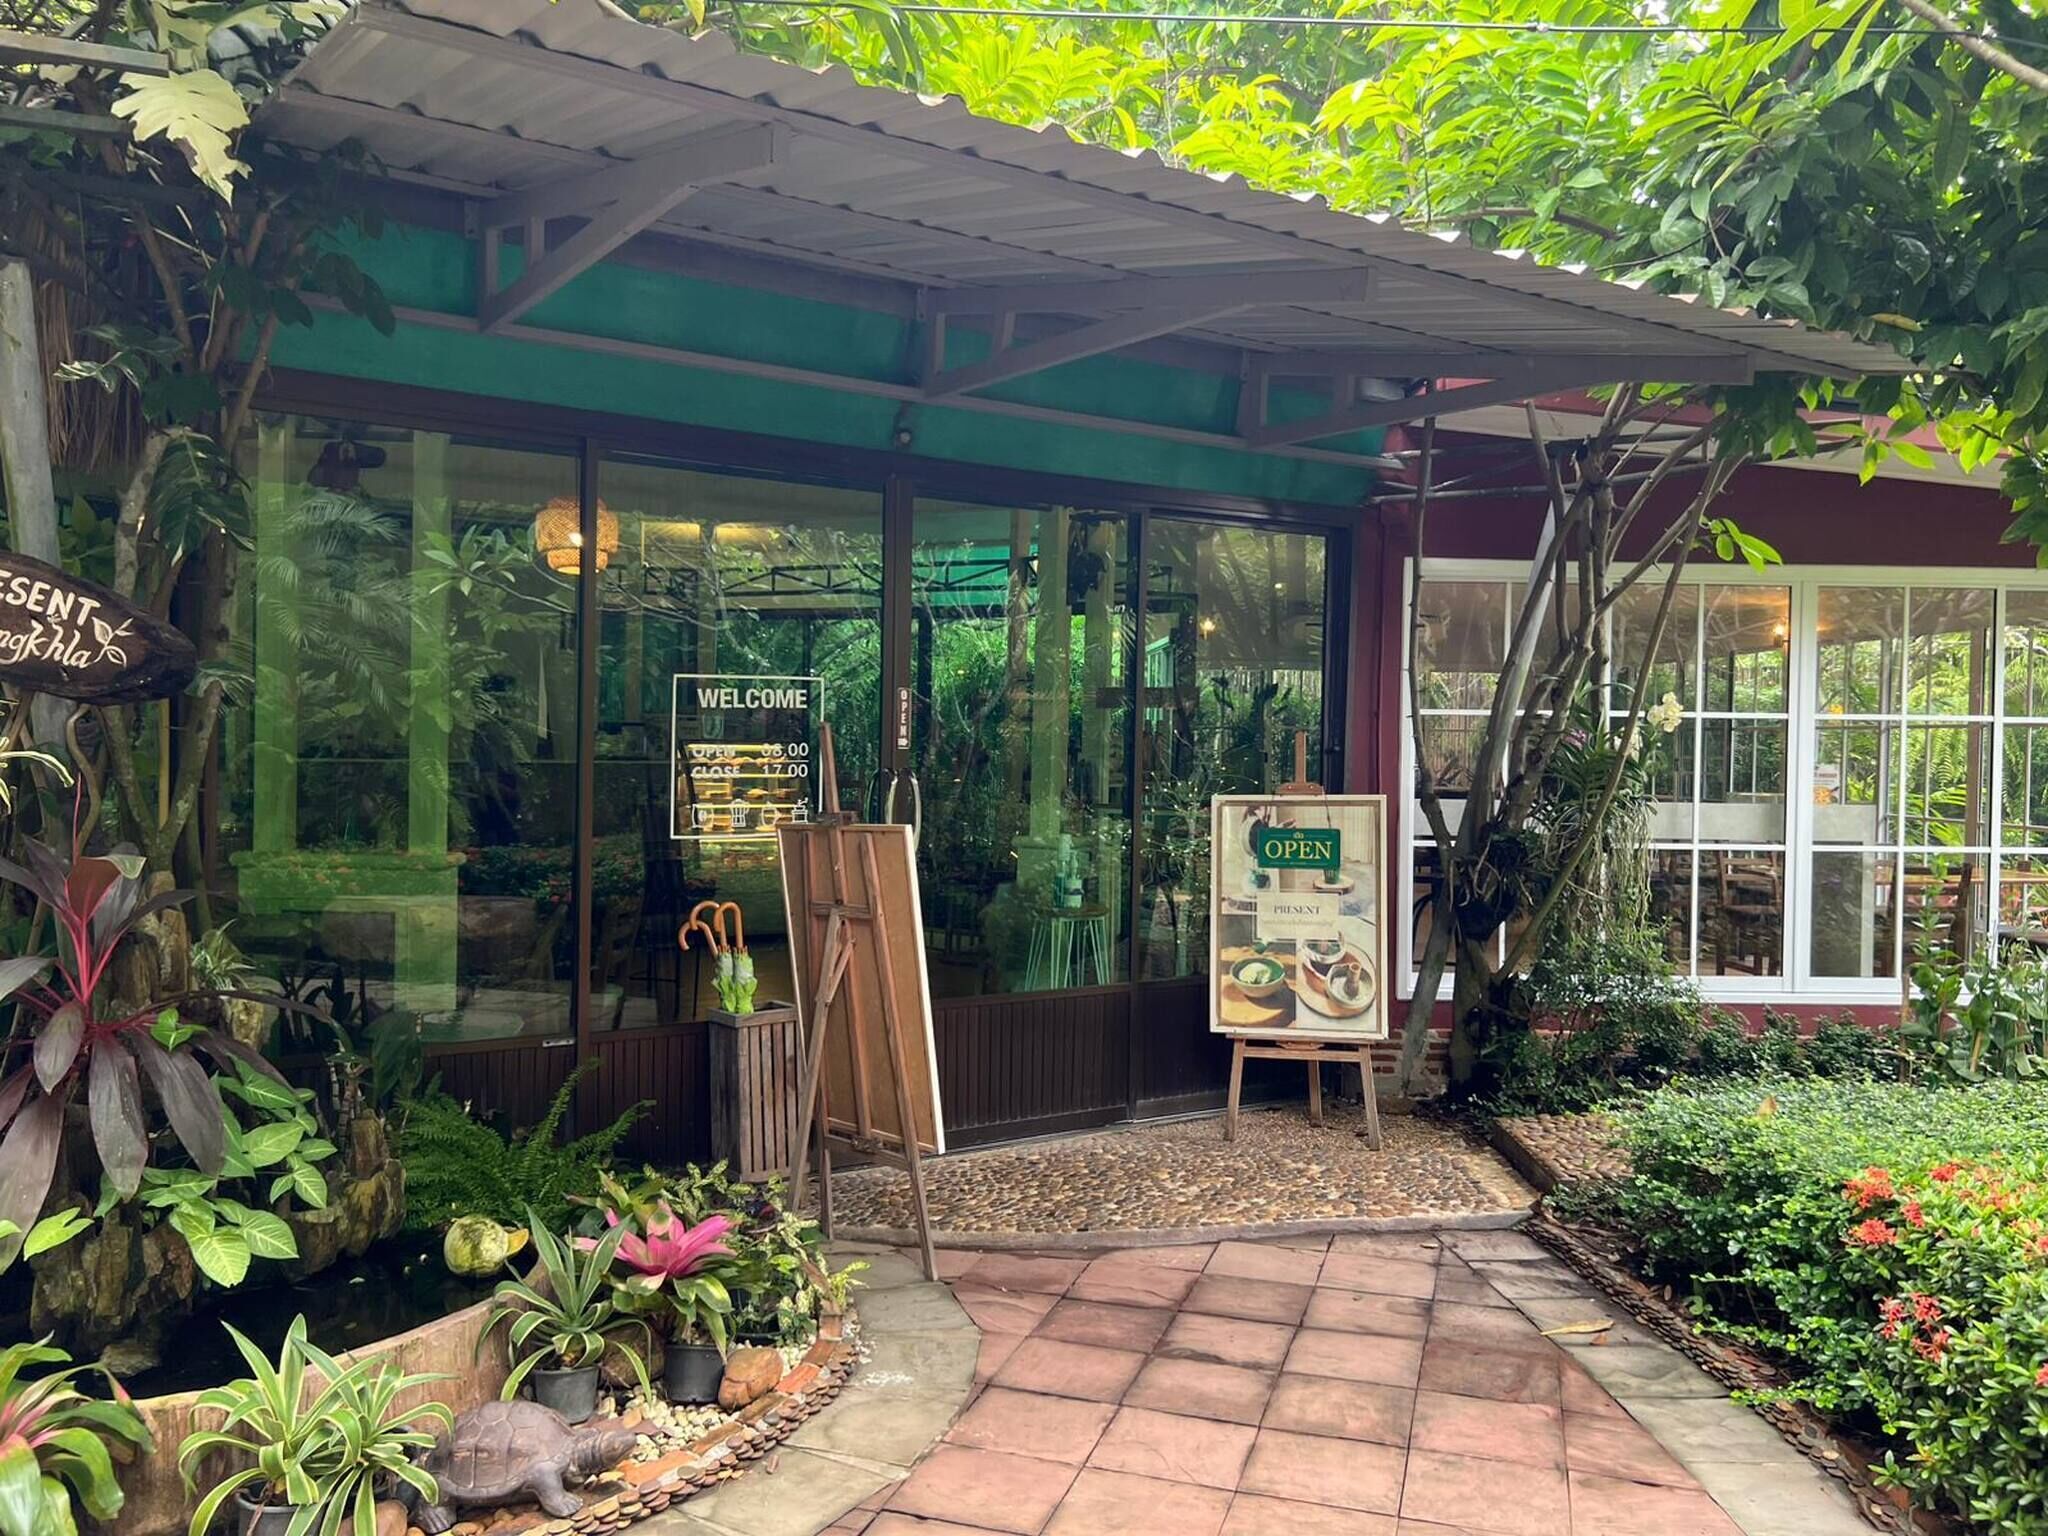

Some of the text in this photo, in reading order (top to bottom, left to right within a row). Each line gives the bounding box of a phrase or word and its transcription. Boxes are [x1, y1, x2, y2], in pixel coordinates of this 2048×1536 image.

[697, 688, 808, 709] WELCOME
[900, 690, 908, 736] OPEN
[692, 743, 809, 757] OPEN 08.00
[692, 766, 741, 778] CLOSE
[1265, 840, 1332, 859] OPEN
[1274, 905, 1320, 915] PRESENT
